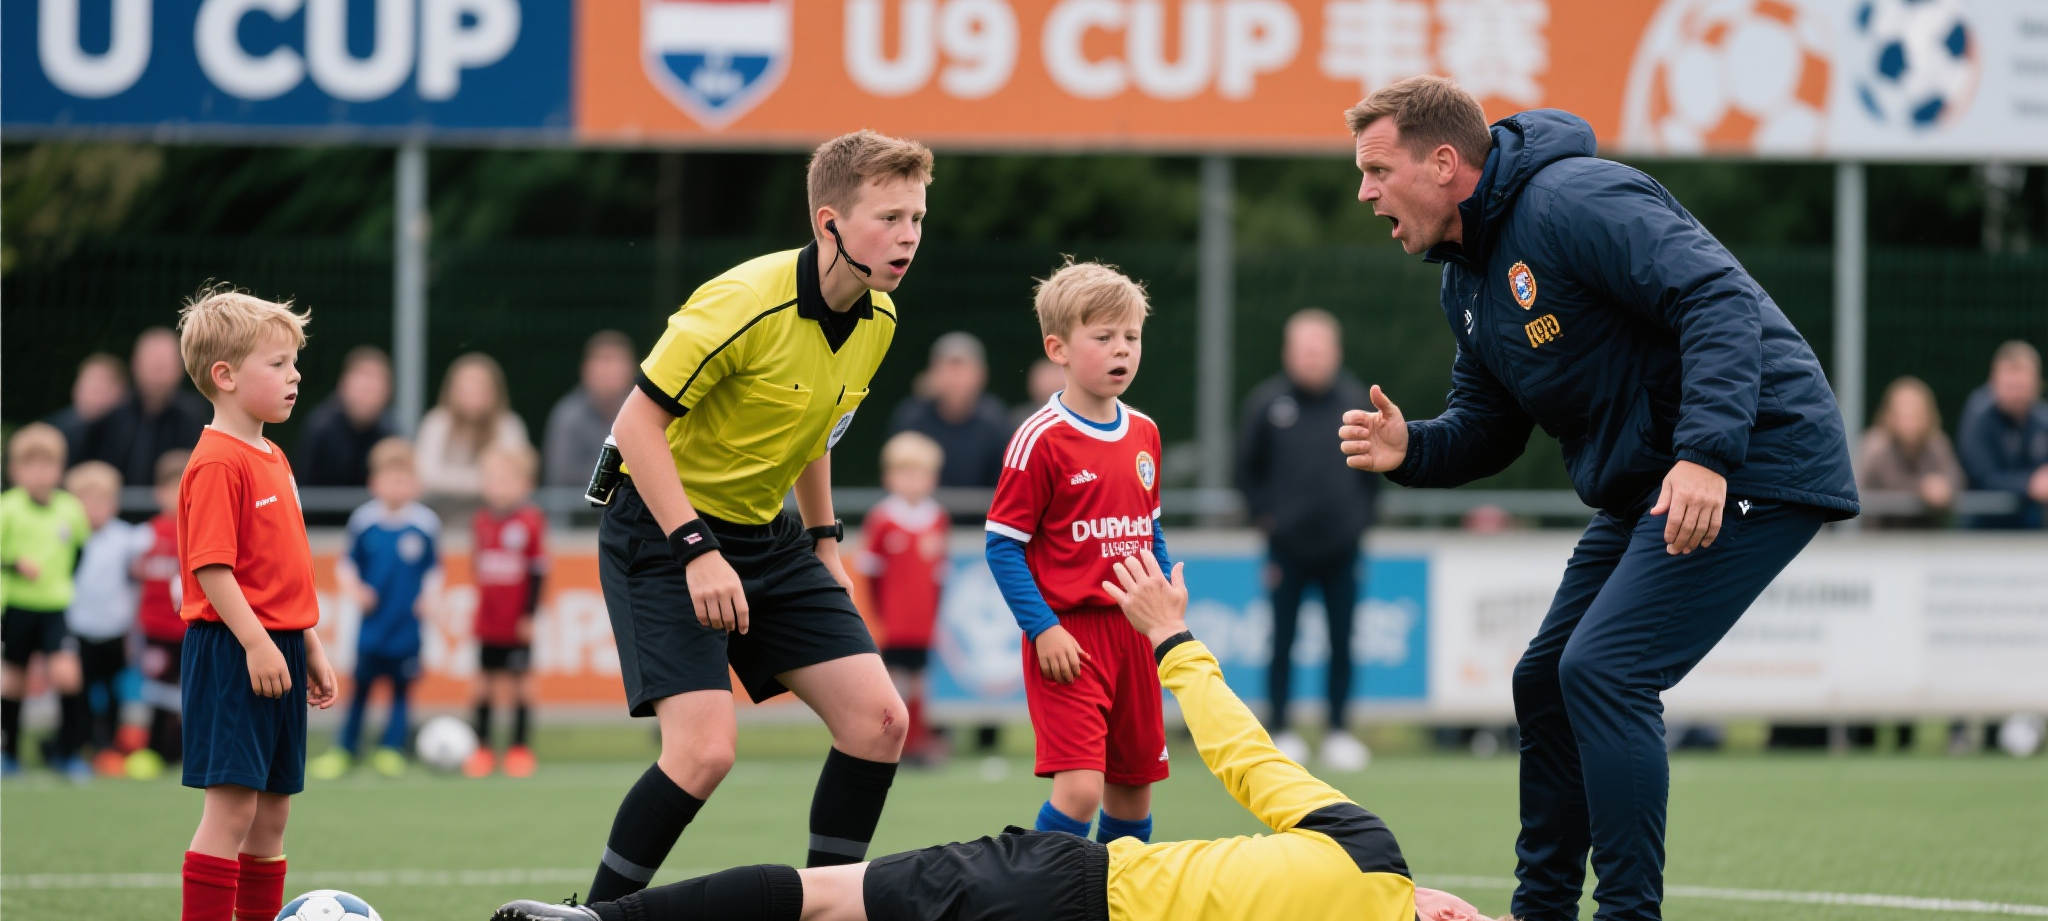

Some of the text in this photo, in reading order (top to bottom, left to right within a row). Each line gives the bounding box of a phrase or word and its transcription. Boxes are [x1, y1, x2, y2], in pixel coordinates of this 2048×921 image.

[195, 0, 522, 100] CUP
[842, 0, 1300, 100] U9 CUP
